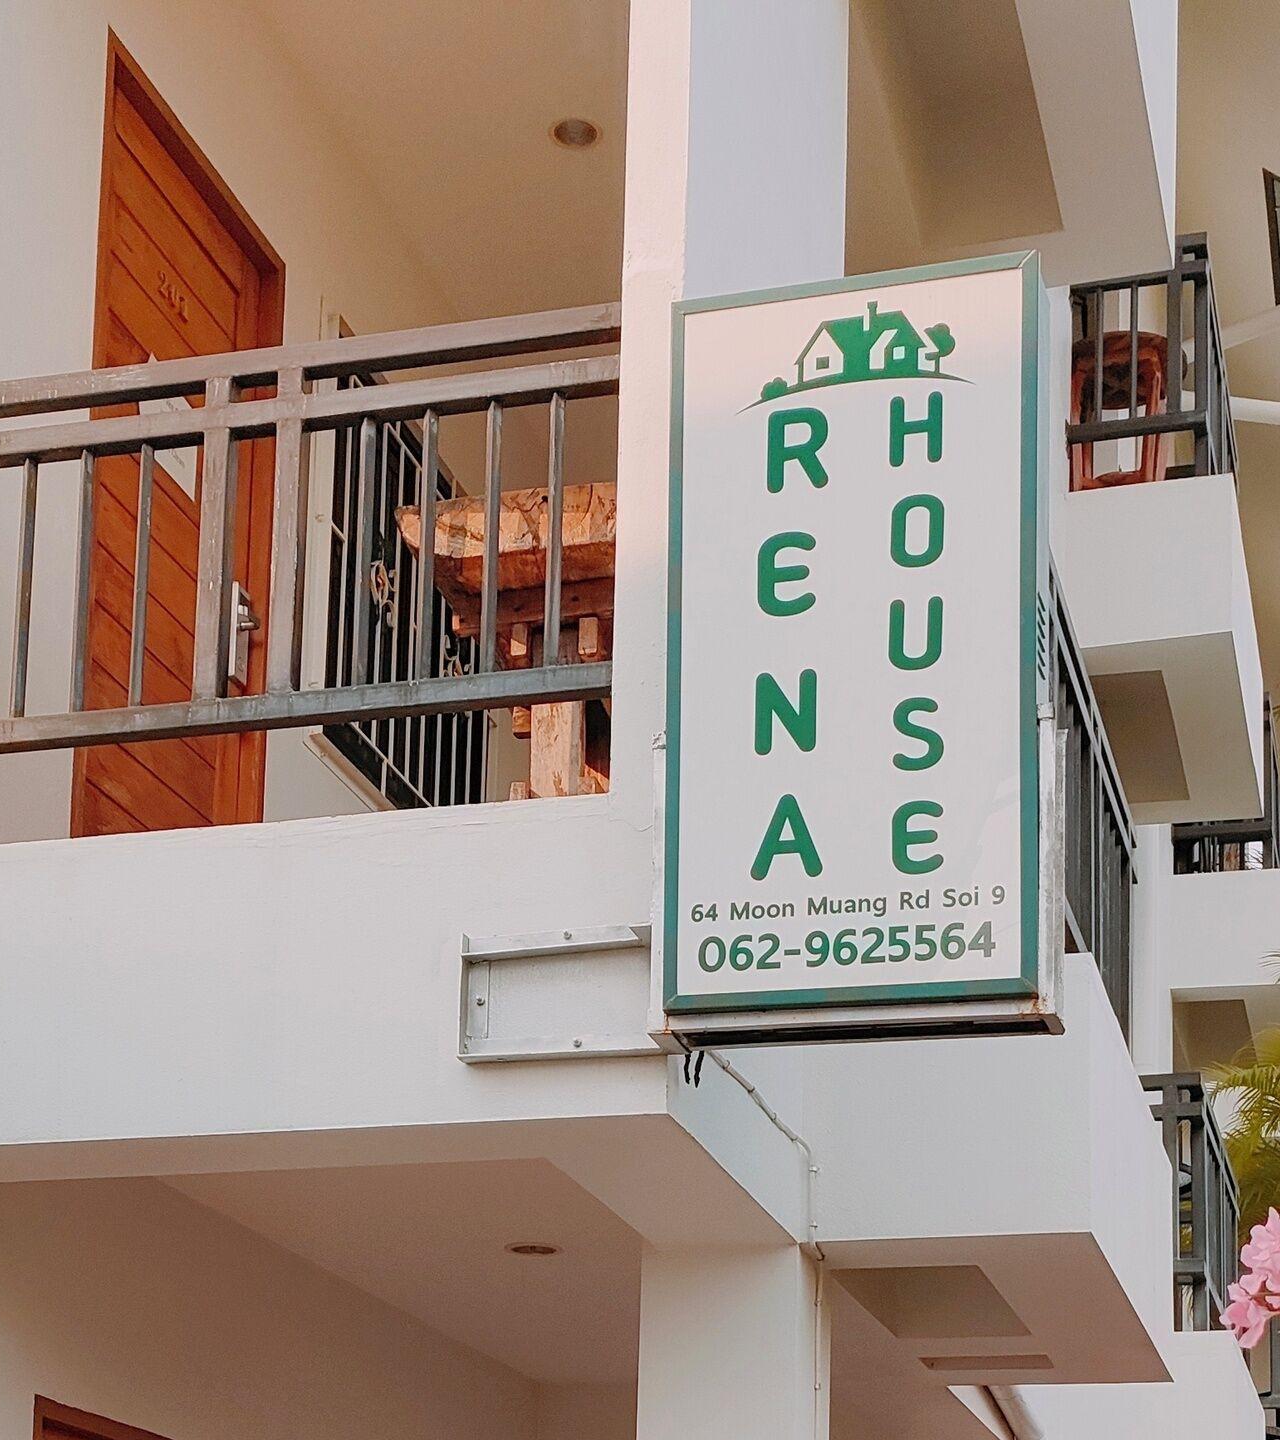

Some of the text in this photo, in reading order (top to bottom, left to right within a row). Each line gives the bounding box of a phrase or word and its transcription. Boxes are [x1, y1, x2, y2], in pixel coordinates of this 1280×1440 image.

[750, 407, 830, 881] RENA
[887, 391, 944, 875] HOUSE
[690, 886, 1006, 922] 64 Moon Muang Rd Soi 9
[698, 921, 996, 973] 062-9625564
